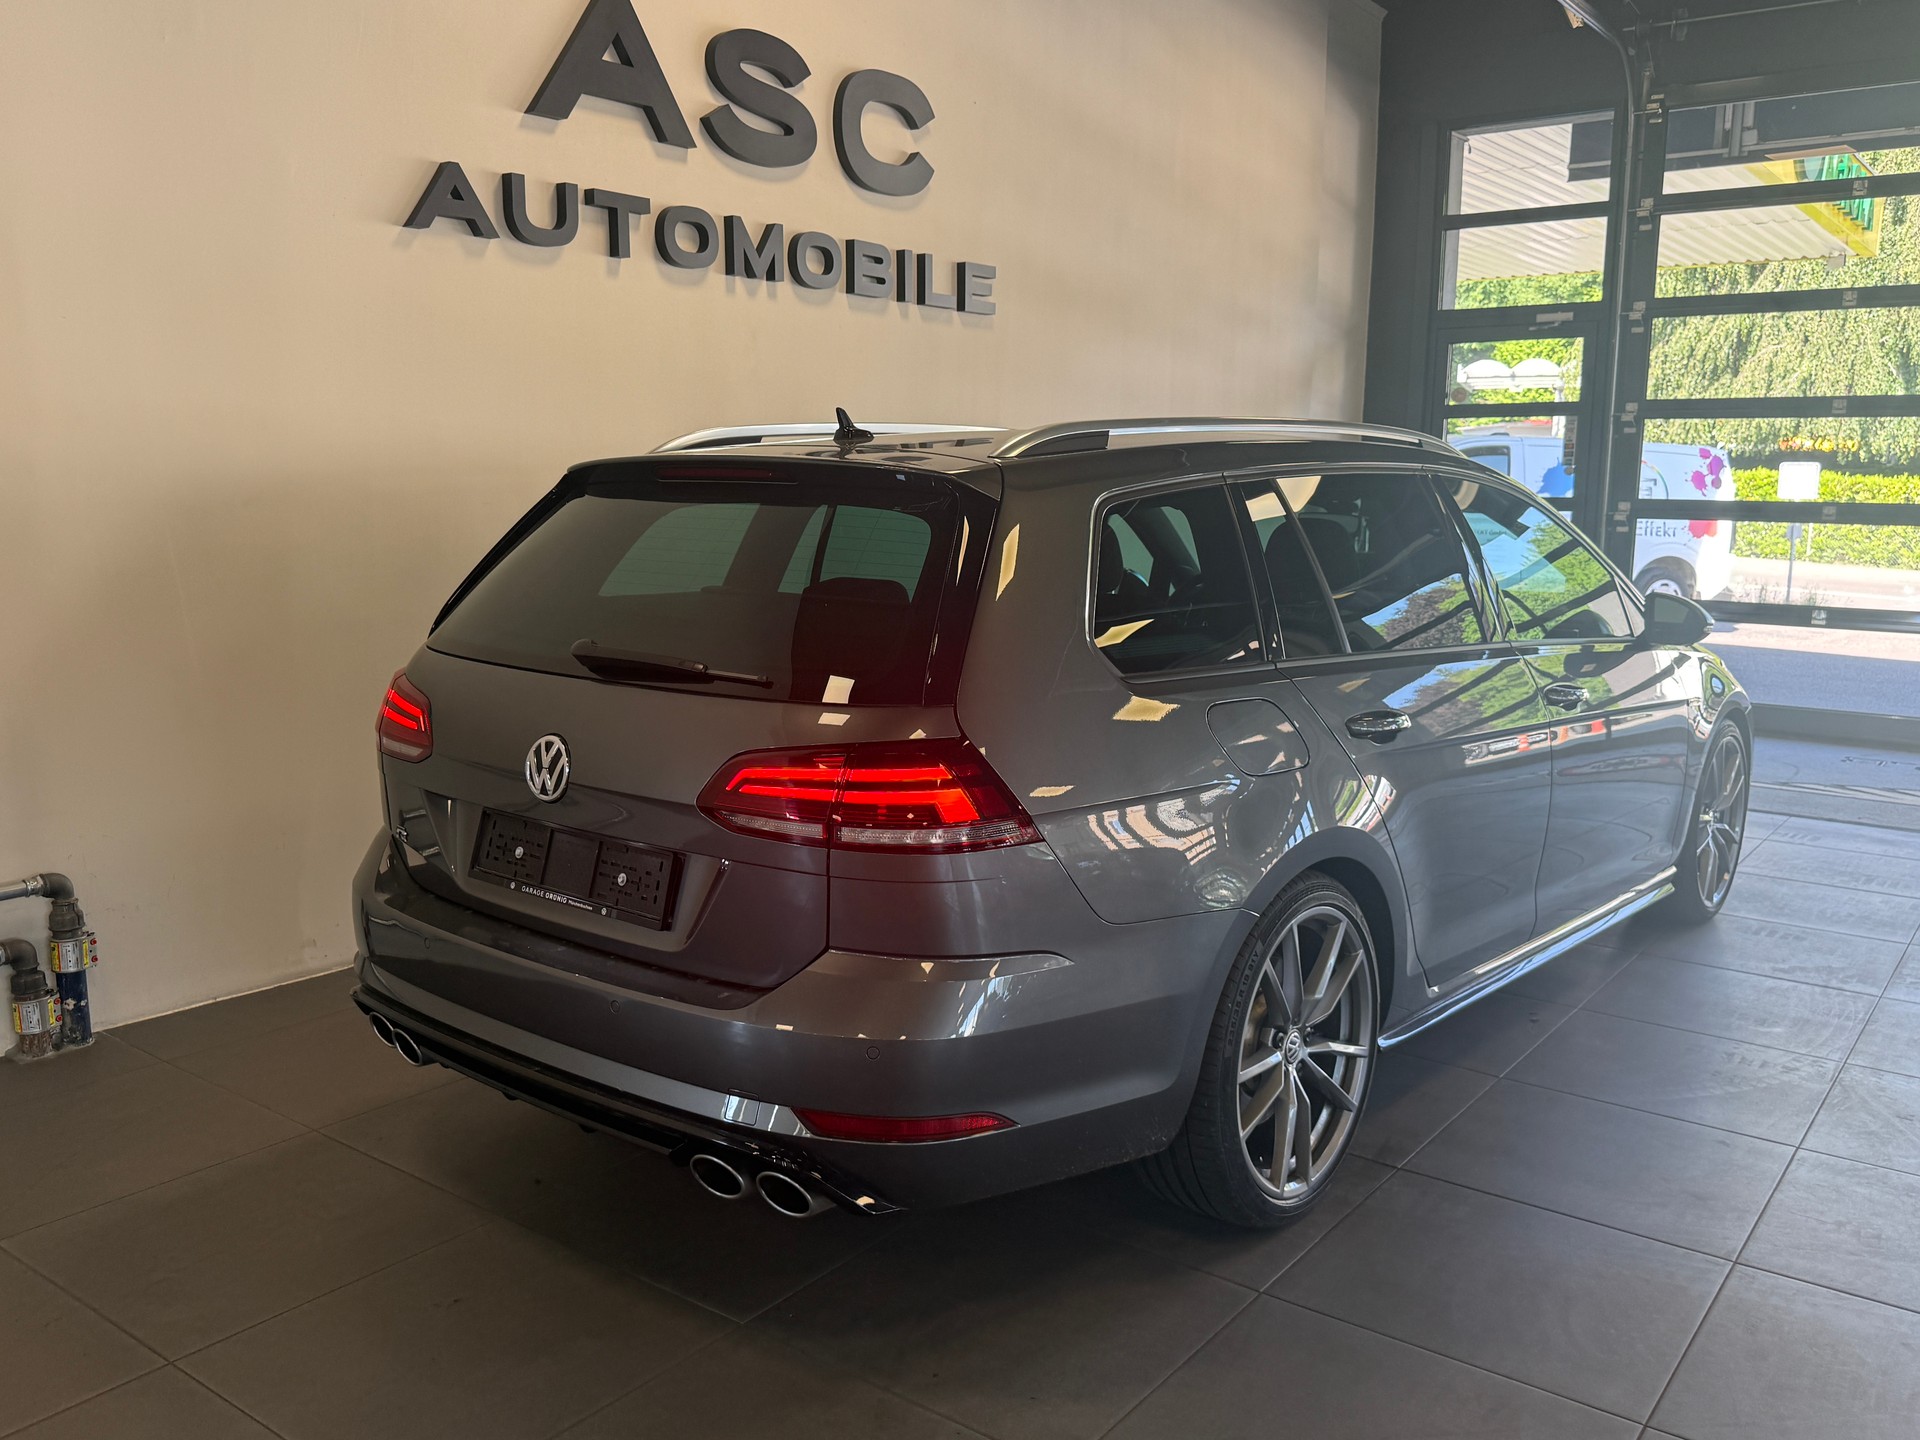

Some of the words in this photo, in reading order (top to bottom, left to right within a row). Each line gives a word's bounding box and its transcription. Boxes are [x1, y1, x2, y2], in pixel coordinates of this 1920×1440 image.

[524, 0, 935, 196] ASC
[402, 160, 997, 316] AUTOMOBILE
[521, 885, 544, 898] GARAGE
